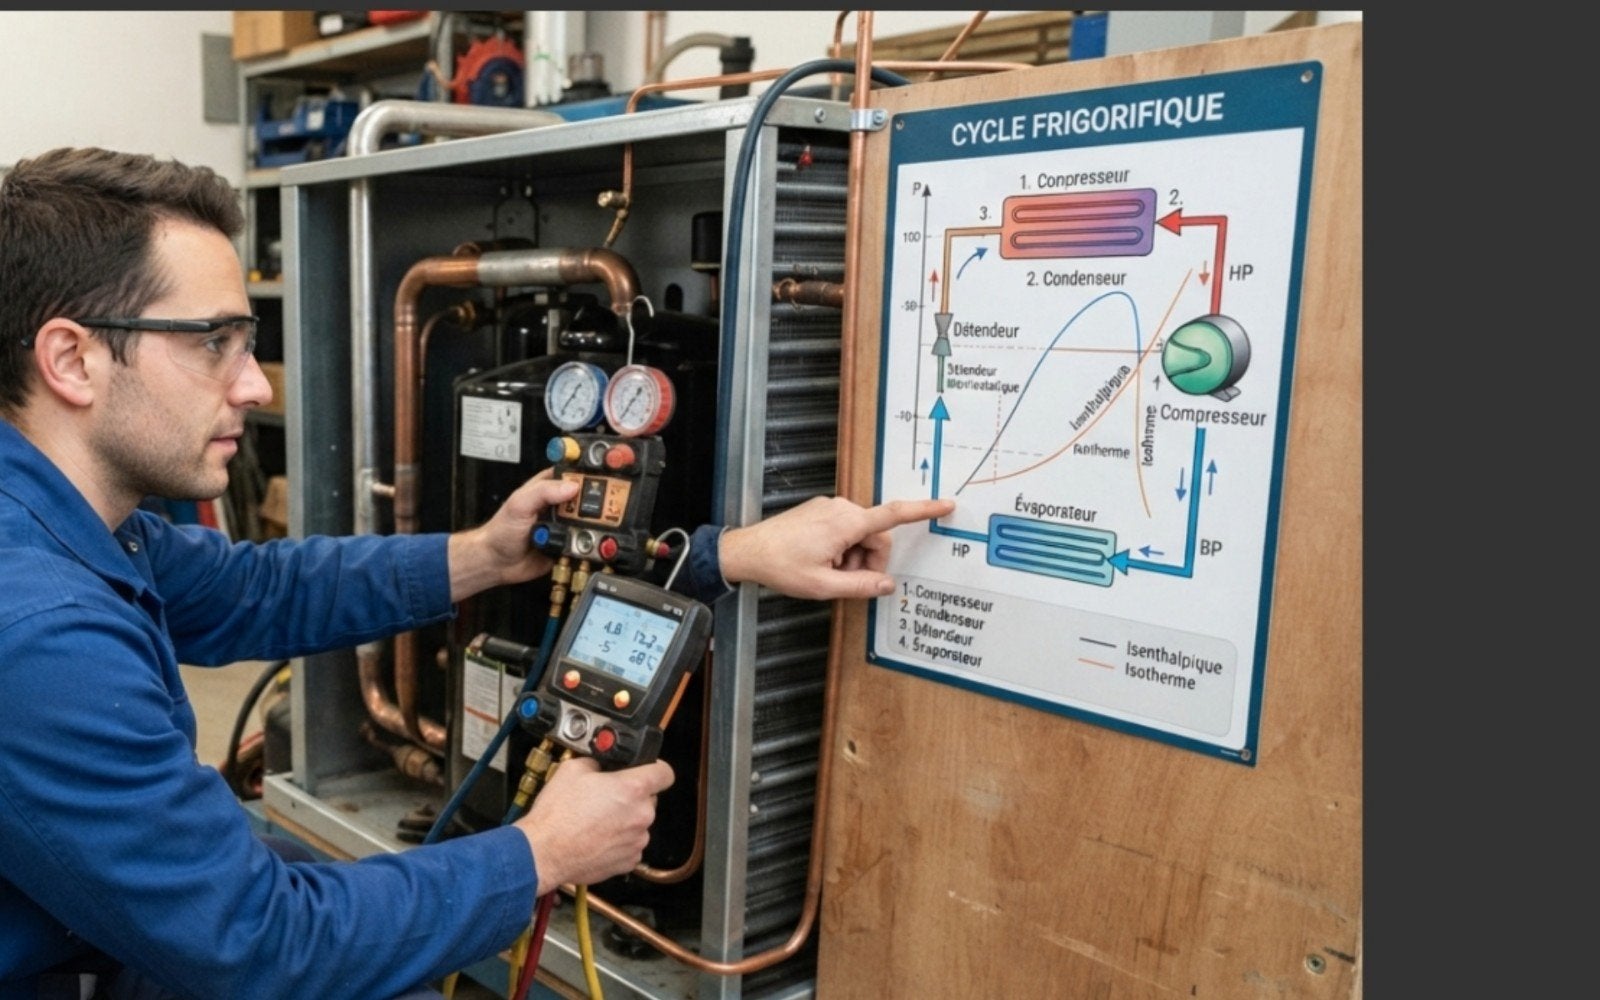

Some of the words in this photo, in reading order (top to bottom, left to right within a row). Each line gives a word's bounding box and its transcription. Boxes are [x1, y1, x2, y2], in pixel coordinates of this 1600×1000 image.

[951, 115, 1026, 146] CYCLE
[1031, 92, 1225, 139] FRIGORIFIQUE
[912, 182, 921, 196] P
[1169, 190, 1183, 206] 2.
[979, 206, 992, 221] 3.
[1027, 272, 1039, 286] 2.
[1043, 271, 1127, 287] Condenseur
[1229, 265, 1254, 281] HP
[1161, 403, 1267, 426] Compresseur
[952, 542, 970, 558] HP
[1200, 539, 1222, 556] BP
[1125, 661, 1196, 690] Isotherme
